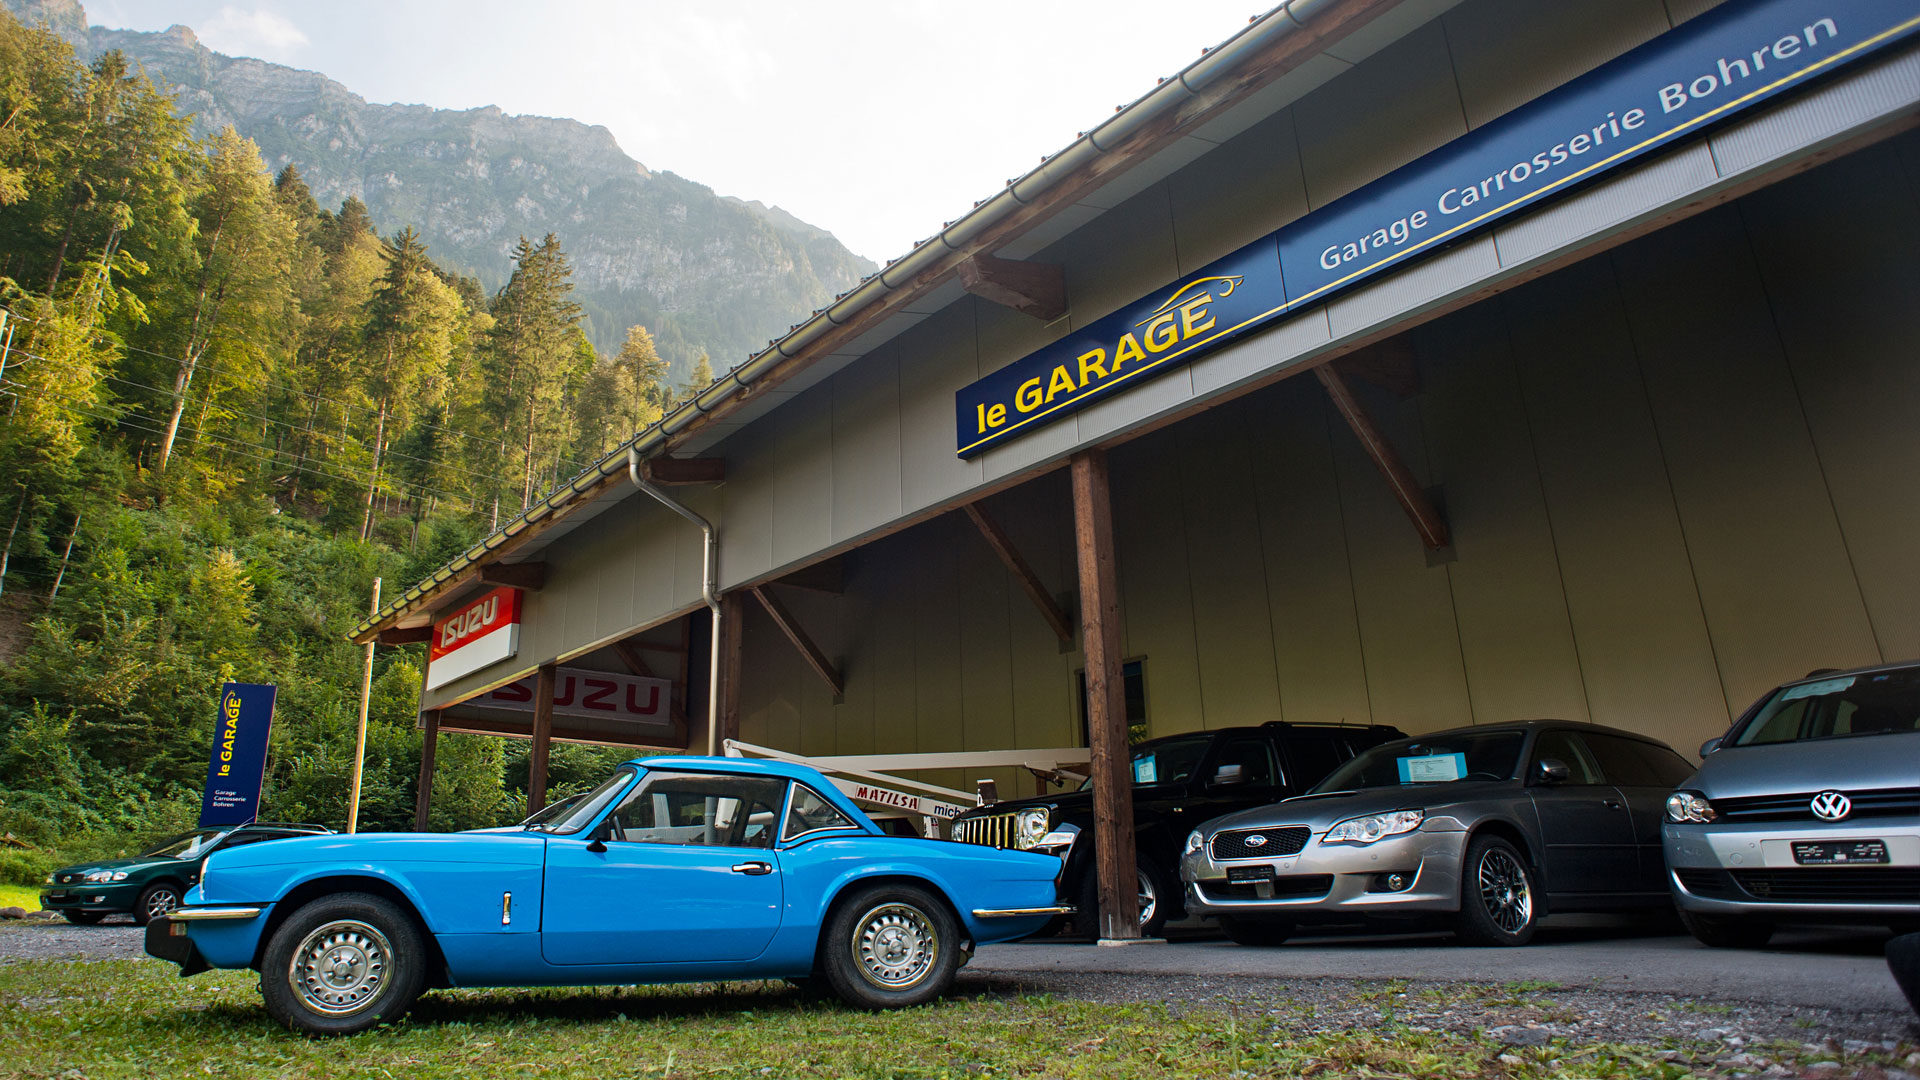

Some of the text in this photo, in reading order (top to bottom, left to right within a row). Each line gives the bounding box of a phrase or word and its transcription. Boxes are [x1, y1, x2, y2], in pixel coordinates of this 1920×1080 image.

[1319, 16, 1839, 271] Garage Carrosserie Bohren
[977, 294, 1217, 434] le GARAGE
[440, 595, 498, 649] ISUZU
[475, 675, 660, 716] SUZU
[217, 698, 242, 777] le GARAGE
[215, 789, 237, 797] Garage
[857, 786, 918, 810] MATILSA
